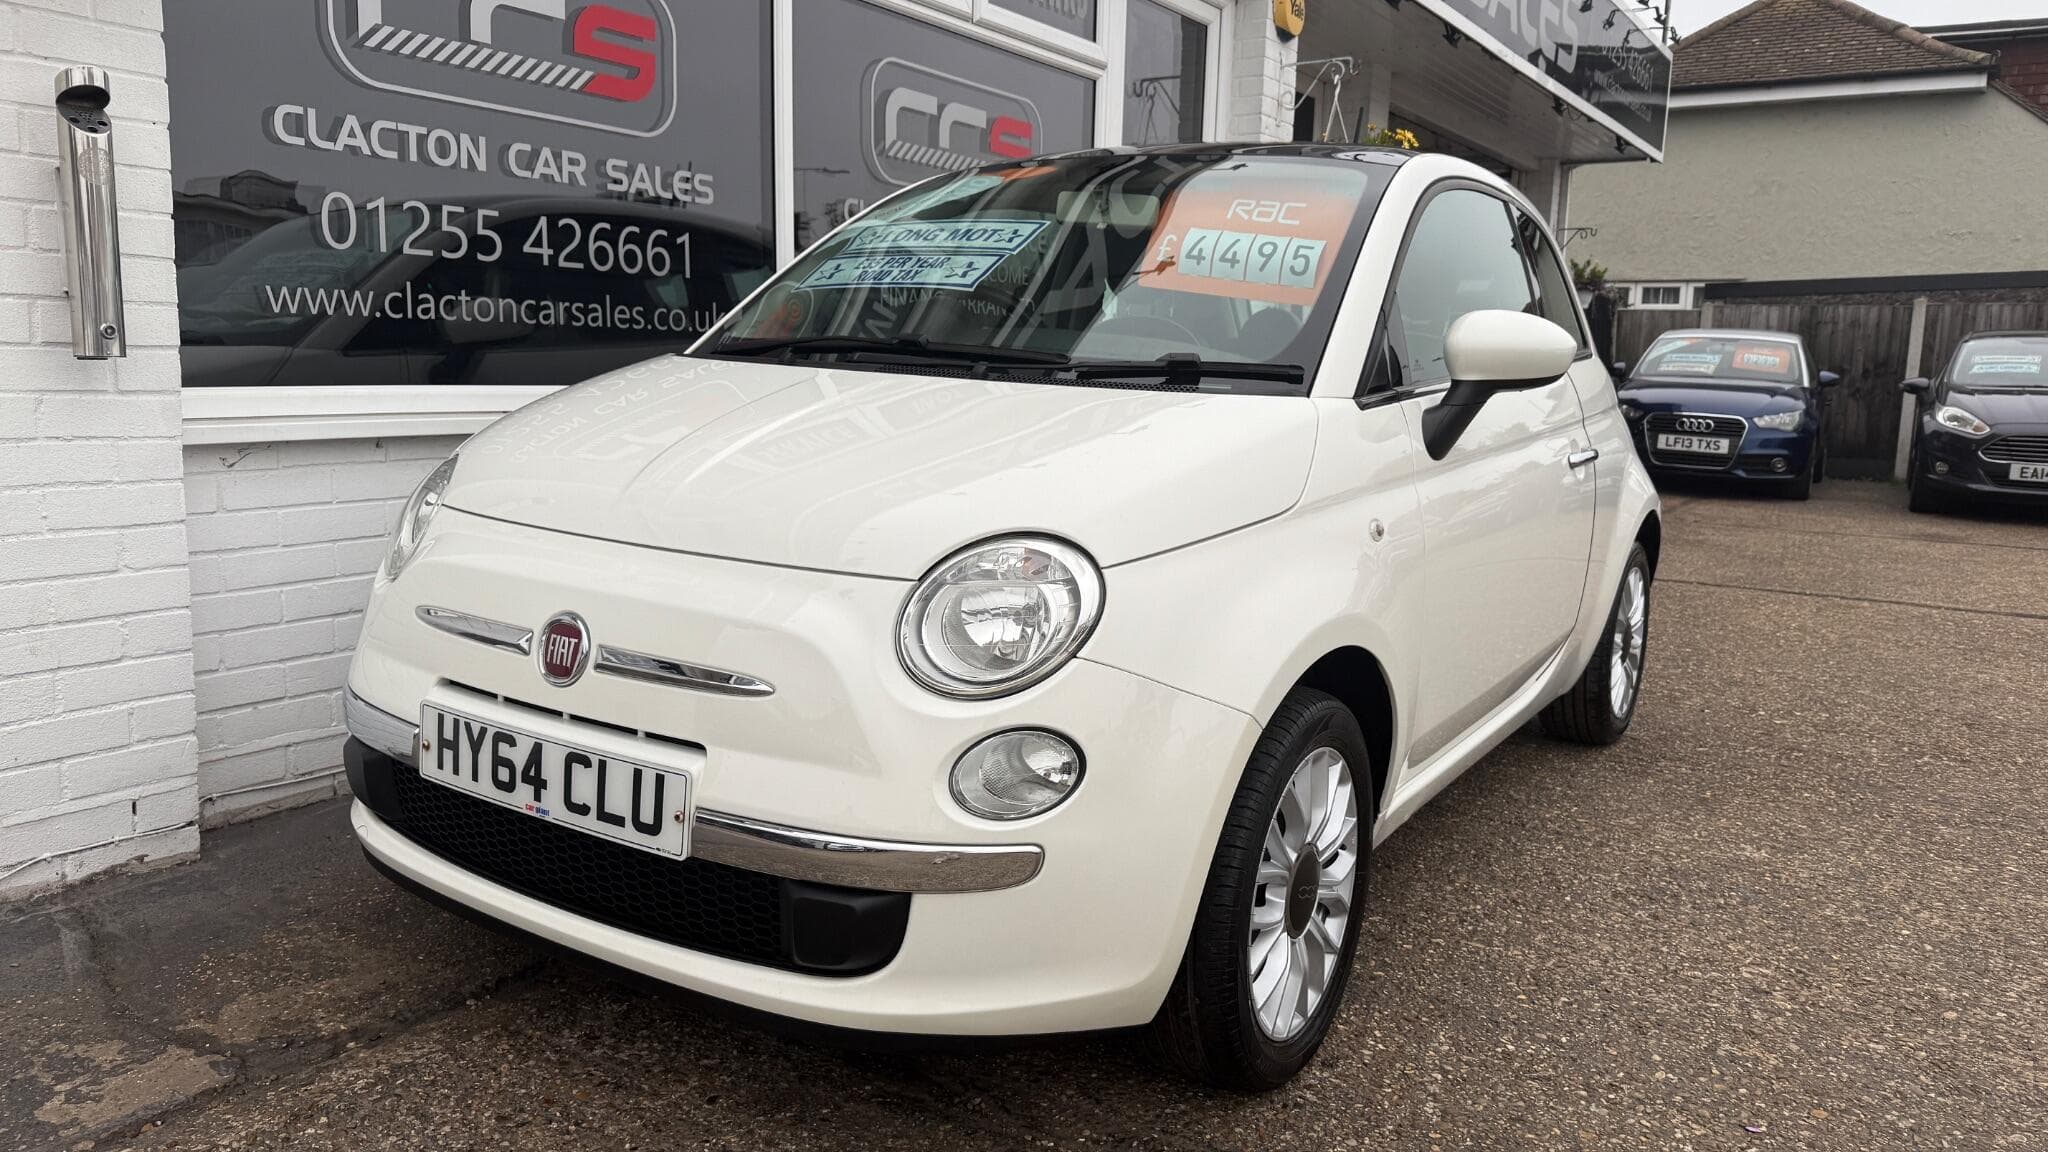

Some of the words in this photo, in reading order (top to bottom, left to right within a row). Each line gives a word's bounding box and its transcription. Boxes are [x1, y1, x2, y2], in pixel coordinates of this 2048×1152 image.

[273, 103, 487, 172] CLACTON
[508, 142, 587, 187] CAR
[605, 158, 714, 205] SALES
[320, 191, 502, 263] 01255
[522, 215, 691, 279] 426661
[949, 228, 1003, 243] MOT
[854, 269, 894, 282] ROAD
[891, 269, 925, 282] TAX
[880, 256, 913, 269] PER
[911, 256, 952, 269] YEAR
[264, 280, 730, 333] www.clactoncarsales.co.uk
[1665, 437, 1693, 449] LF13
[1696, 438, 1721, 451] TXS
[547, 633, 579, 668] FIAT
[437, 712, 548, 803] HY64
[563, 751, 665, 837] CLU
